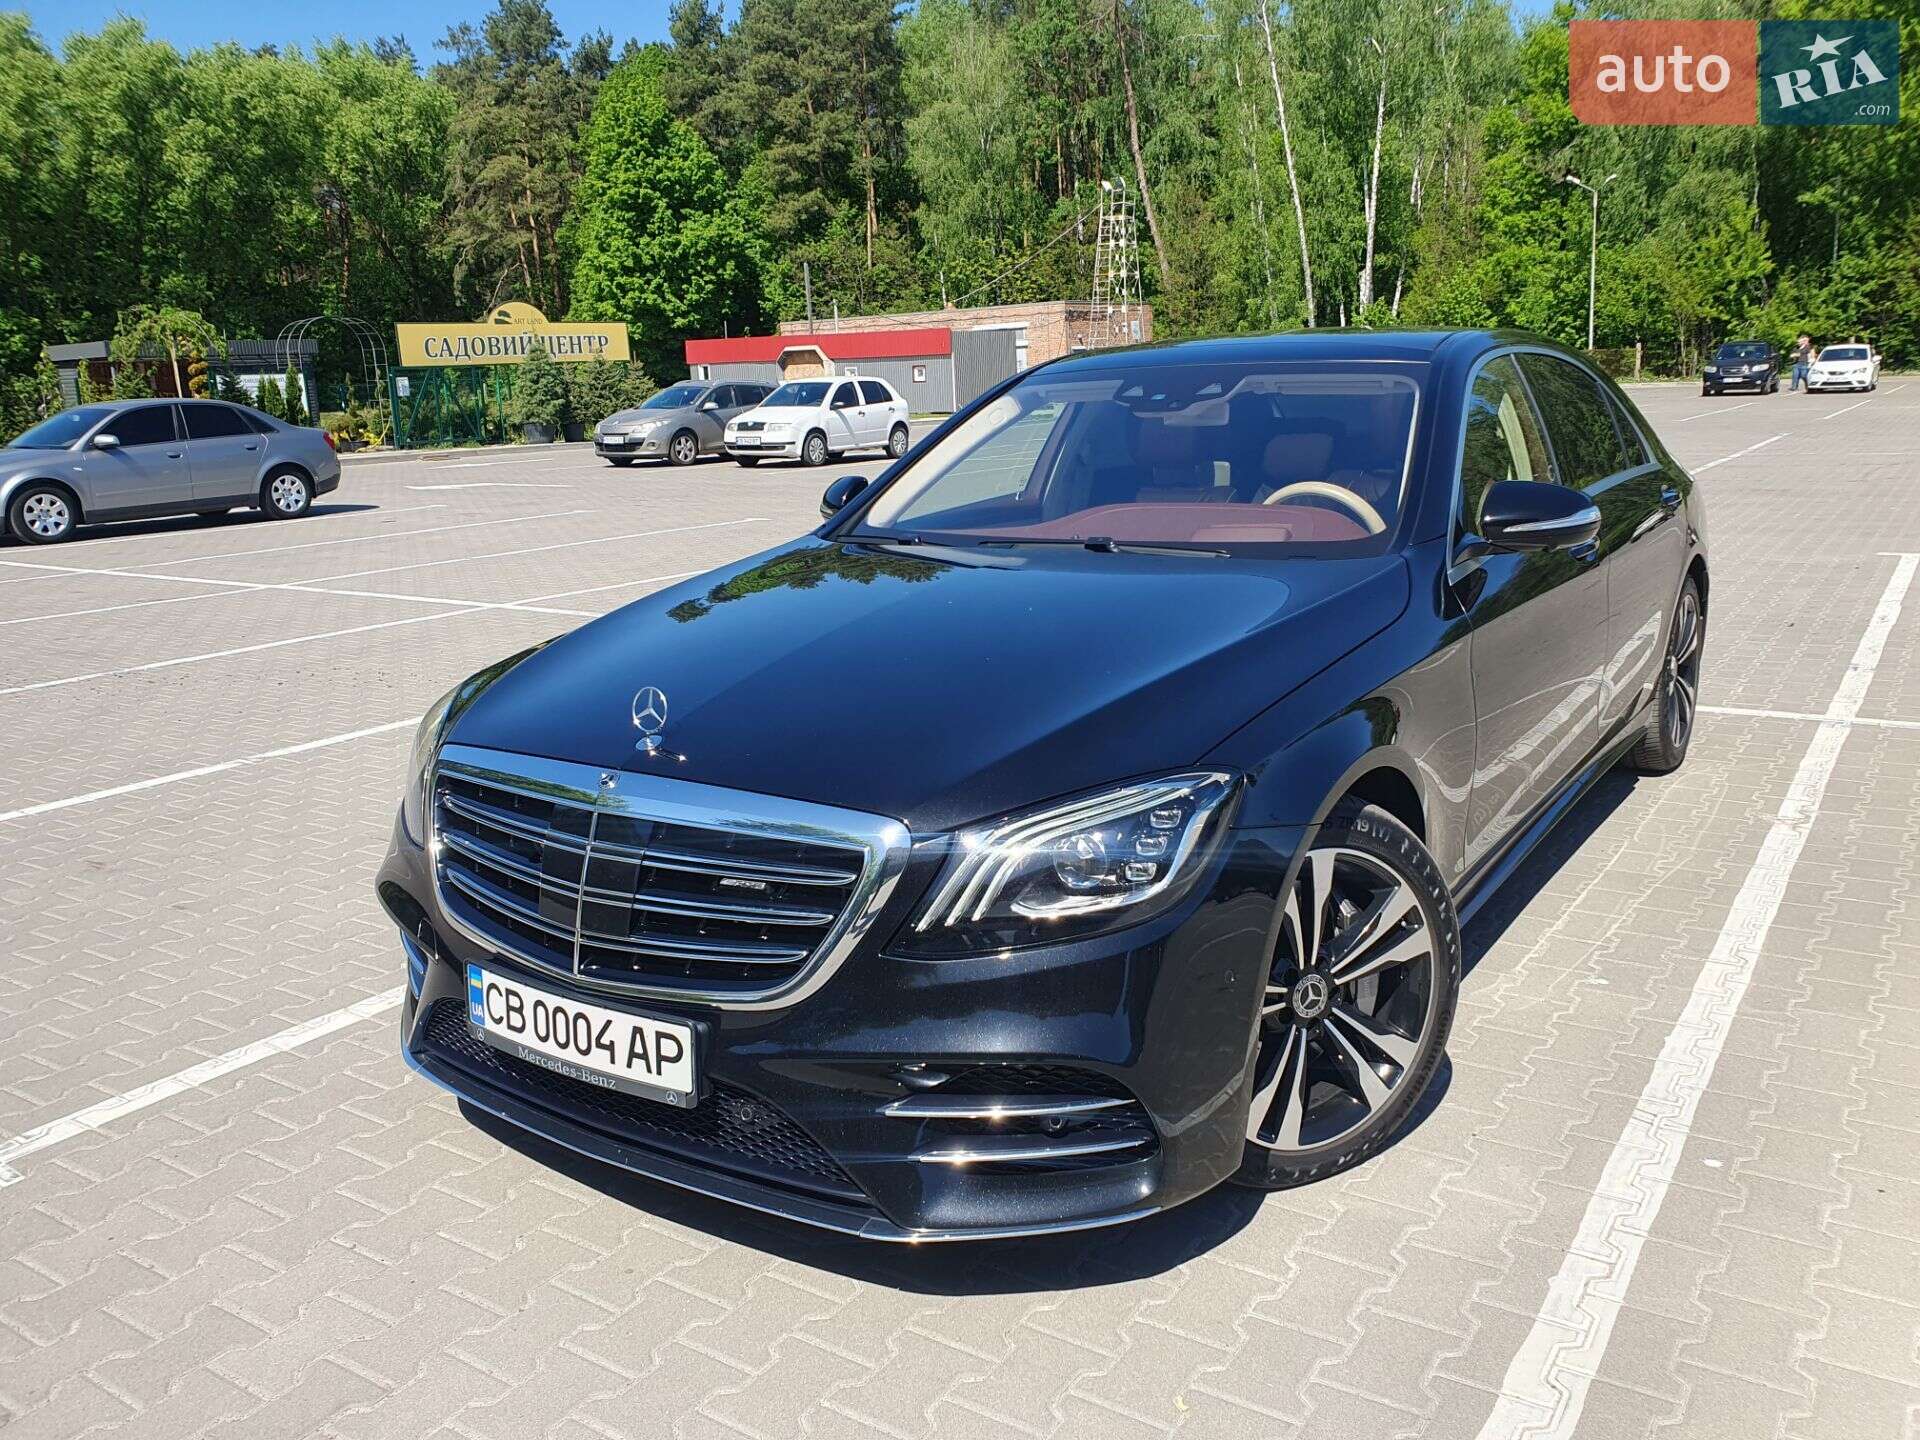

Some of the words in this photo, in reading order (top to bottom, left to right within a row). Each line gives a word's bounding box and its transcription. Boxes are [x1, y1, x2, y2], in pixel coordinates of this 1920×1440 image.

[424, 331, 533, 362] САДОВИЙ
[471, 1001, 485, 1018] UA
[486, 982, 526, 1034] CB
[533, 999, 616, 1066] 0004
[626, 1025, 684, 1076] AP
[518, 1046, 617, 1090] Mercedes-Benz
